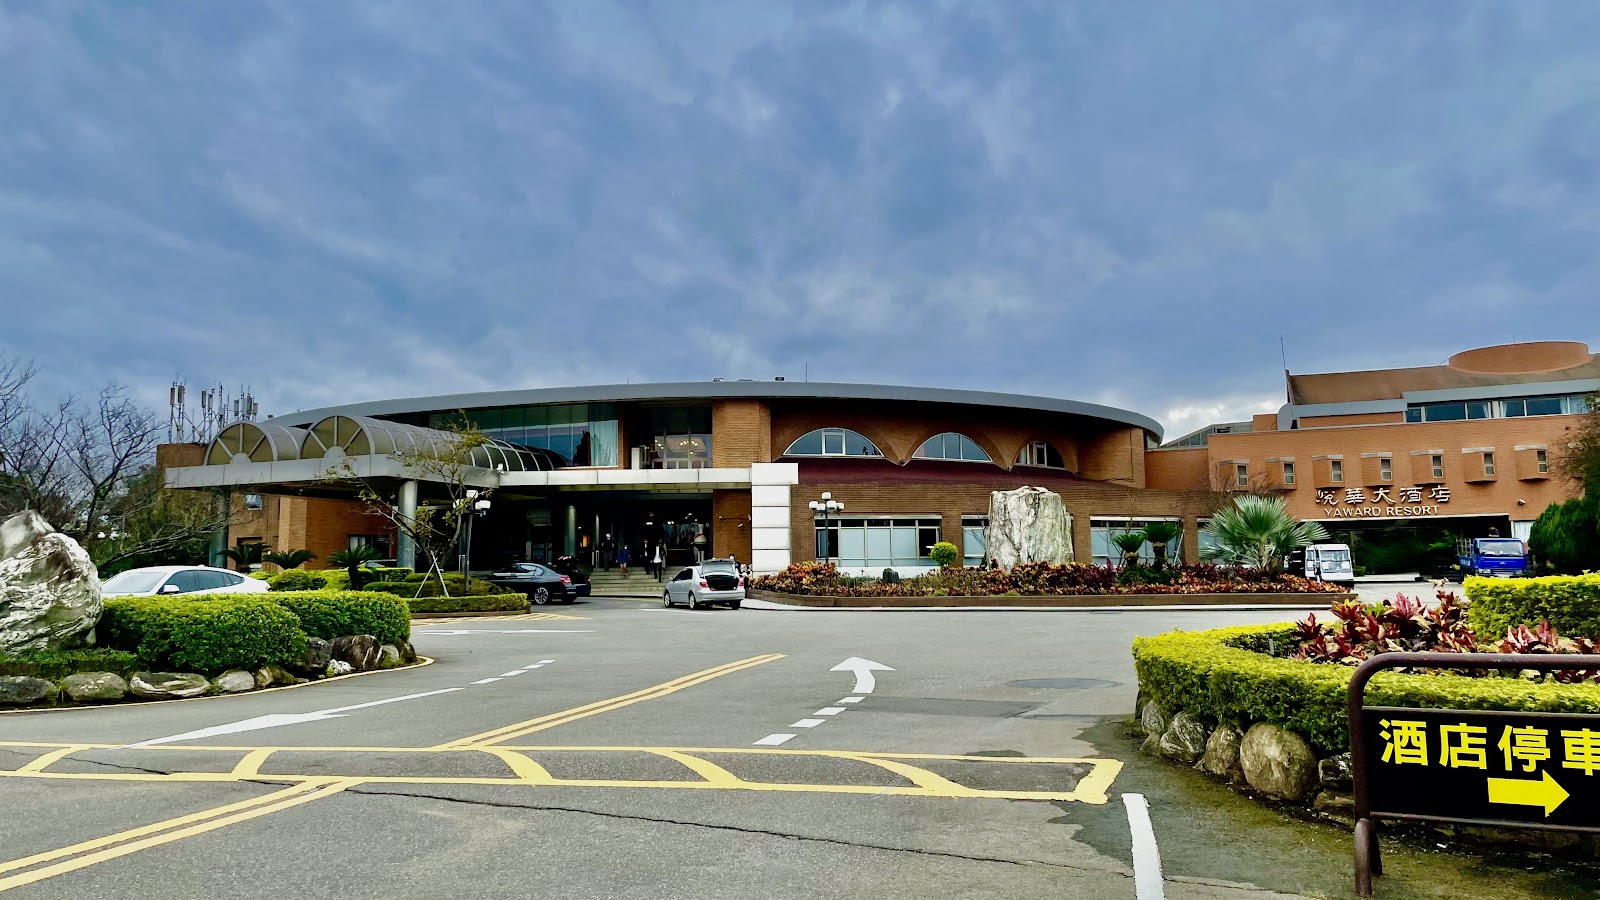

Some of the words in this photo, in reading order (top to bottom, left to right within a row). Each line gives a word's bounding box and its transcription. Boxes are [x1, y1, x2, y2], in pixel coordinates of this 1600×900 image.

[1324, 506, 1381, 518] YAWARD
[1386, 504, 1440, 516] RESORT
[1379, 718, 1600, 776] 酒店停車
